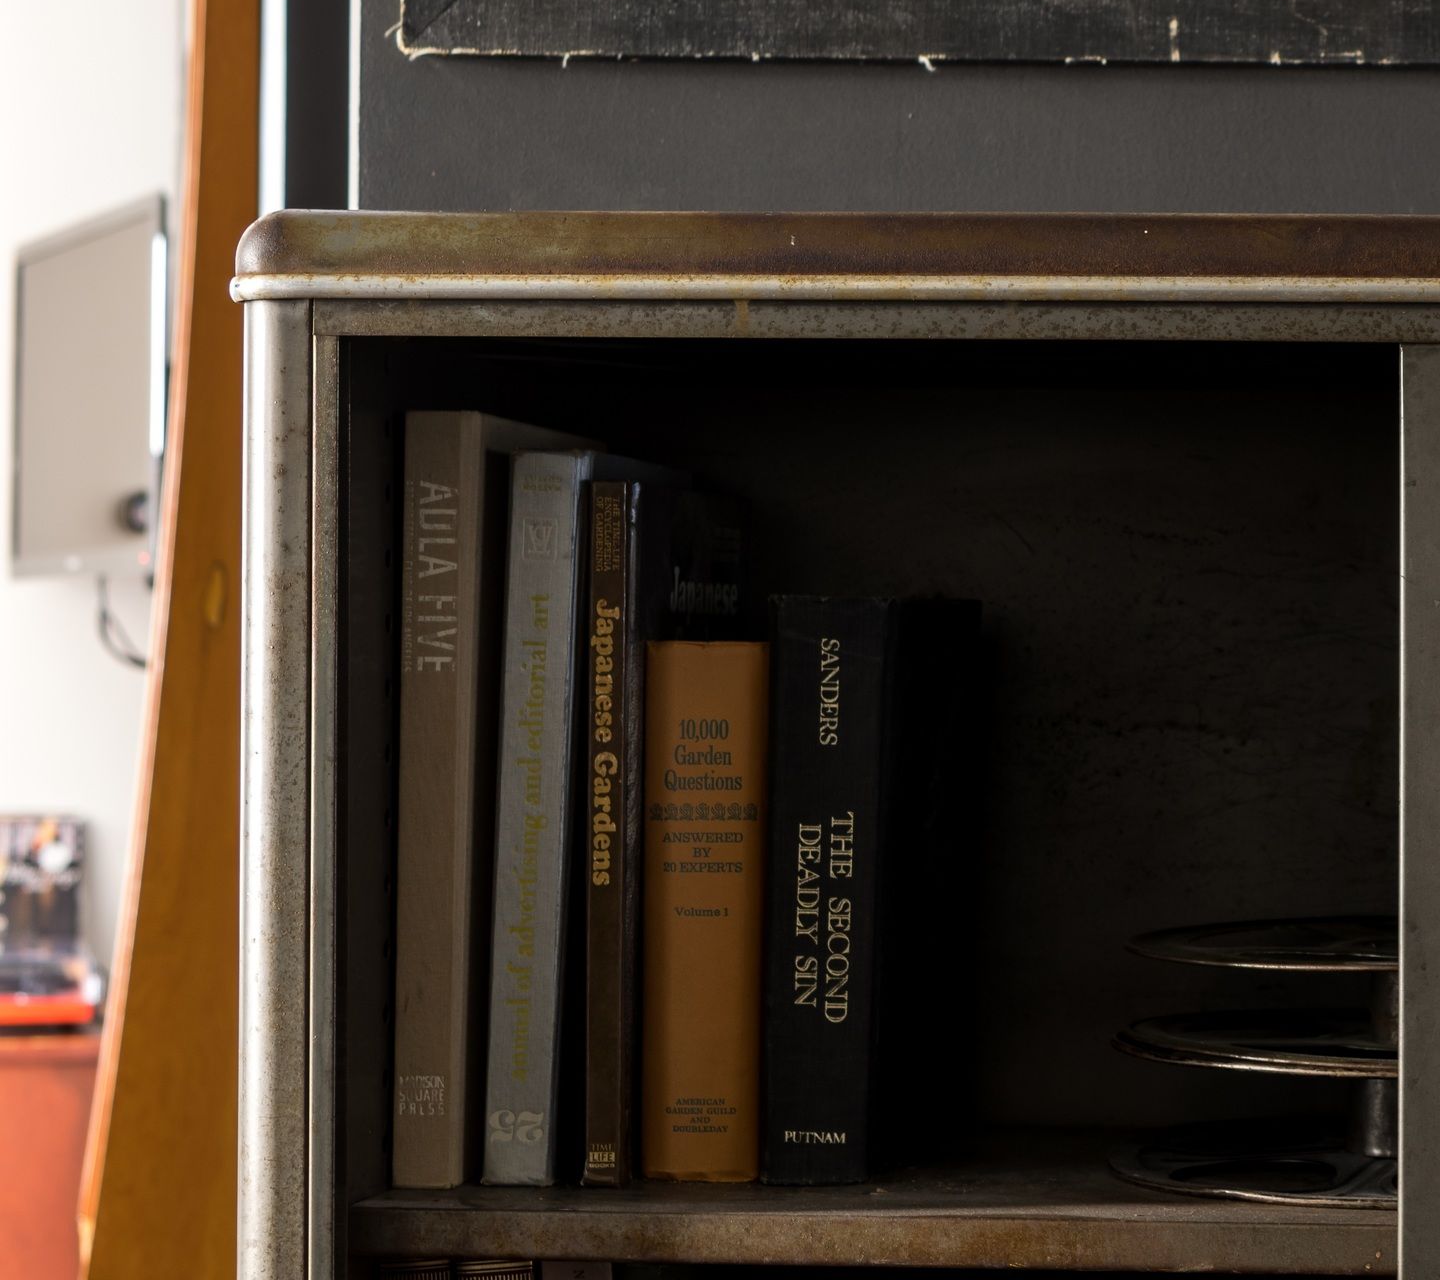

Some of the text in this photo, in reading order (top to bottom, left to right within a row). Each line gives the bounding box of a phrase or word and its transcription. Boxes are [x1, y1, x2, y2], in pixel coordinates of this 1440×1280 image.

[417, 479, 458, 673] AULA FIVE
[528, 593, 551, 631] art
[518, 639, 547, 751] editorial
[818, 636, 841, 748] SANDERS
[591, 598, 620, 889] Japanese Gardens
[678, 719, 729, 742] 10,000
[674, 744, 733, 766] Garden
[516, 757, 543, 805] and
[664, 771, 744, 793] Questions
[663, 831, 744, 844] ANSWERED
[691, 847, 712, 859] BY
[663, 861, 743, 874] 20 EXPERTS
[511, 813, 547, 959] advertising
[674, 906, 720, 918] Volume
[793, 822, 823, 1009] DEADLY SIN
[824, 810, 856, 1024] THE SECOND
[508, 961, 530, 995] of
[674, 1097, 726, 1107] AMERICAN
[672, 1124, 730, 1134] DOUBLEDAY
[784, 1129, 847, 1145] PUTNAM
